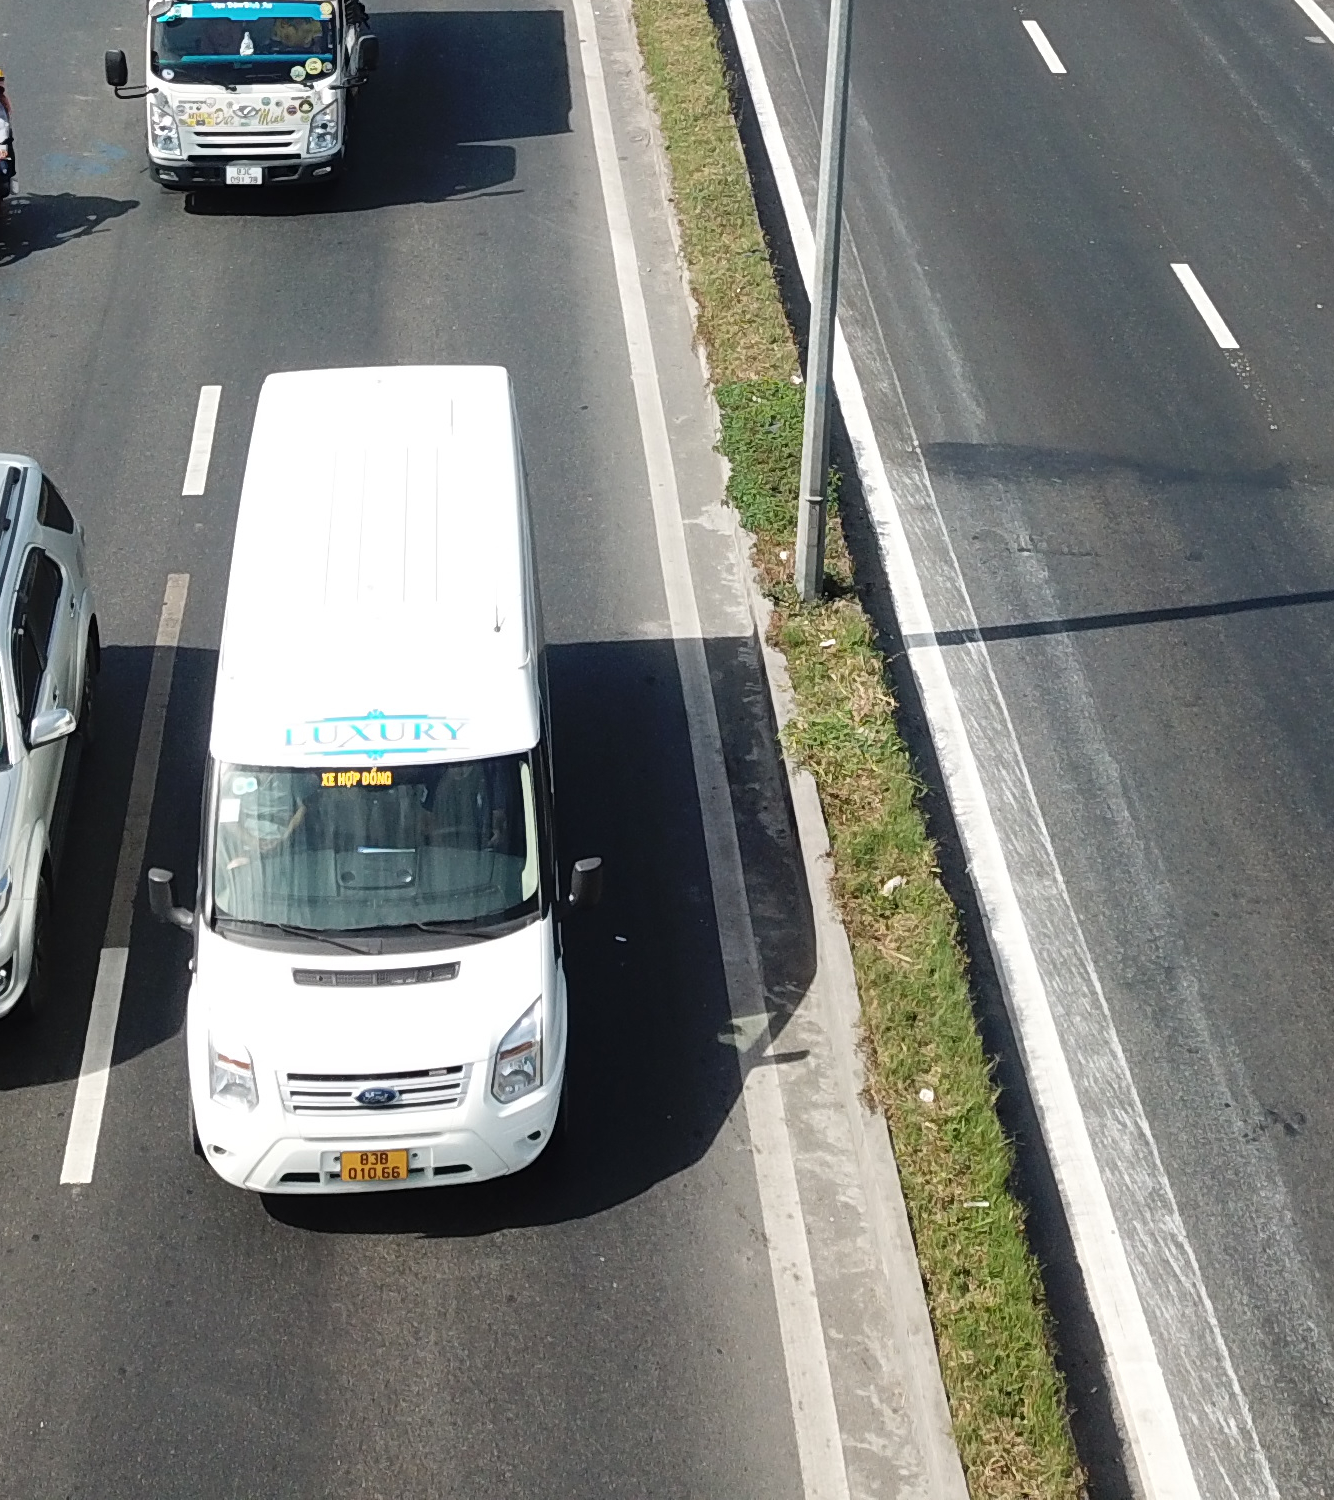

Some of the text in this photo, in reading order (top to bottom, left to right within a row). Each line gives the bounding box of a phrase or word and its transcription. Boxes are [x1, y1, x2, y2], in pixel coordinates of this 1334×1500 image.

[284, 721, 469, 748] LUXURY
[321, 772, 336, 787] XE
[337, 770, 362, 788] HỢP
